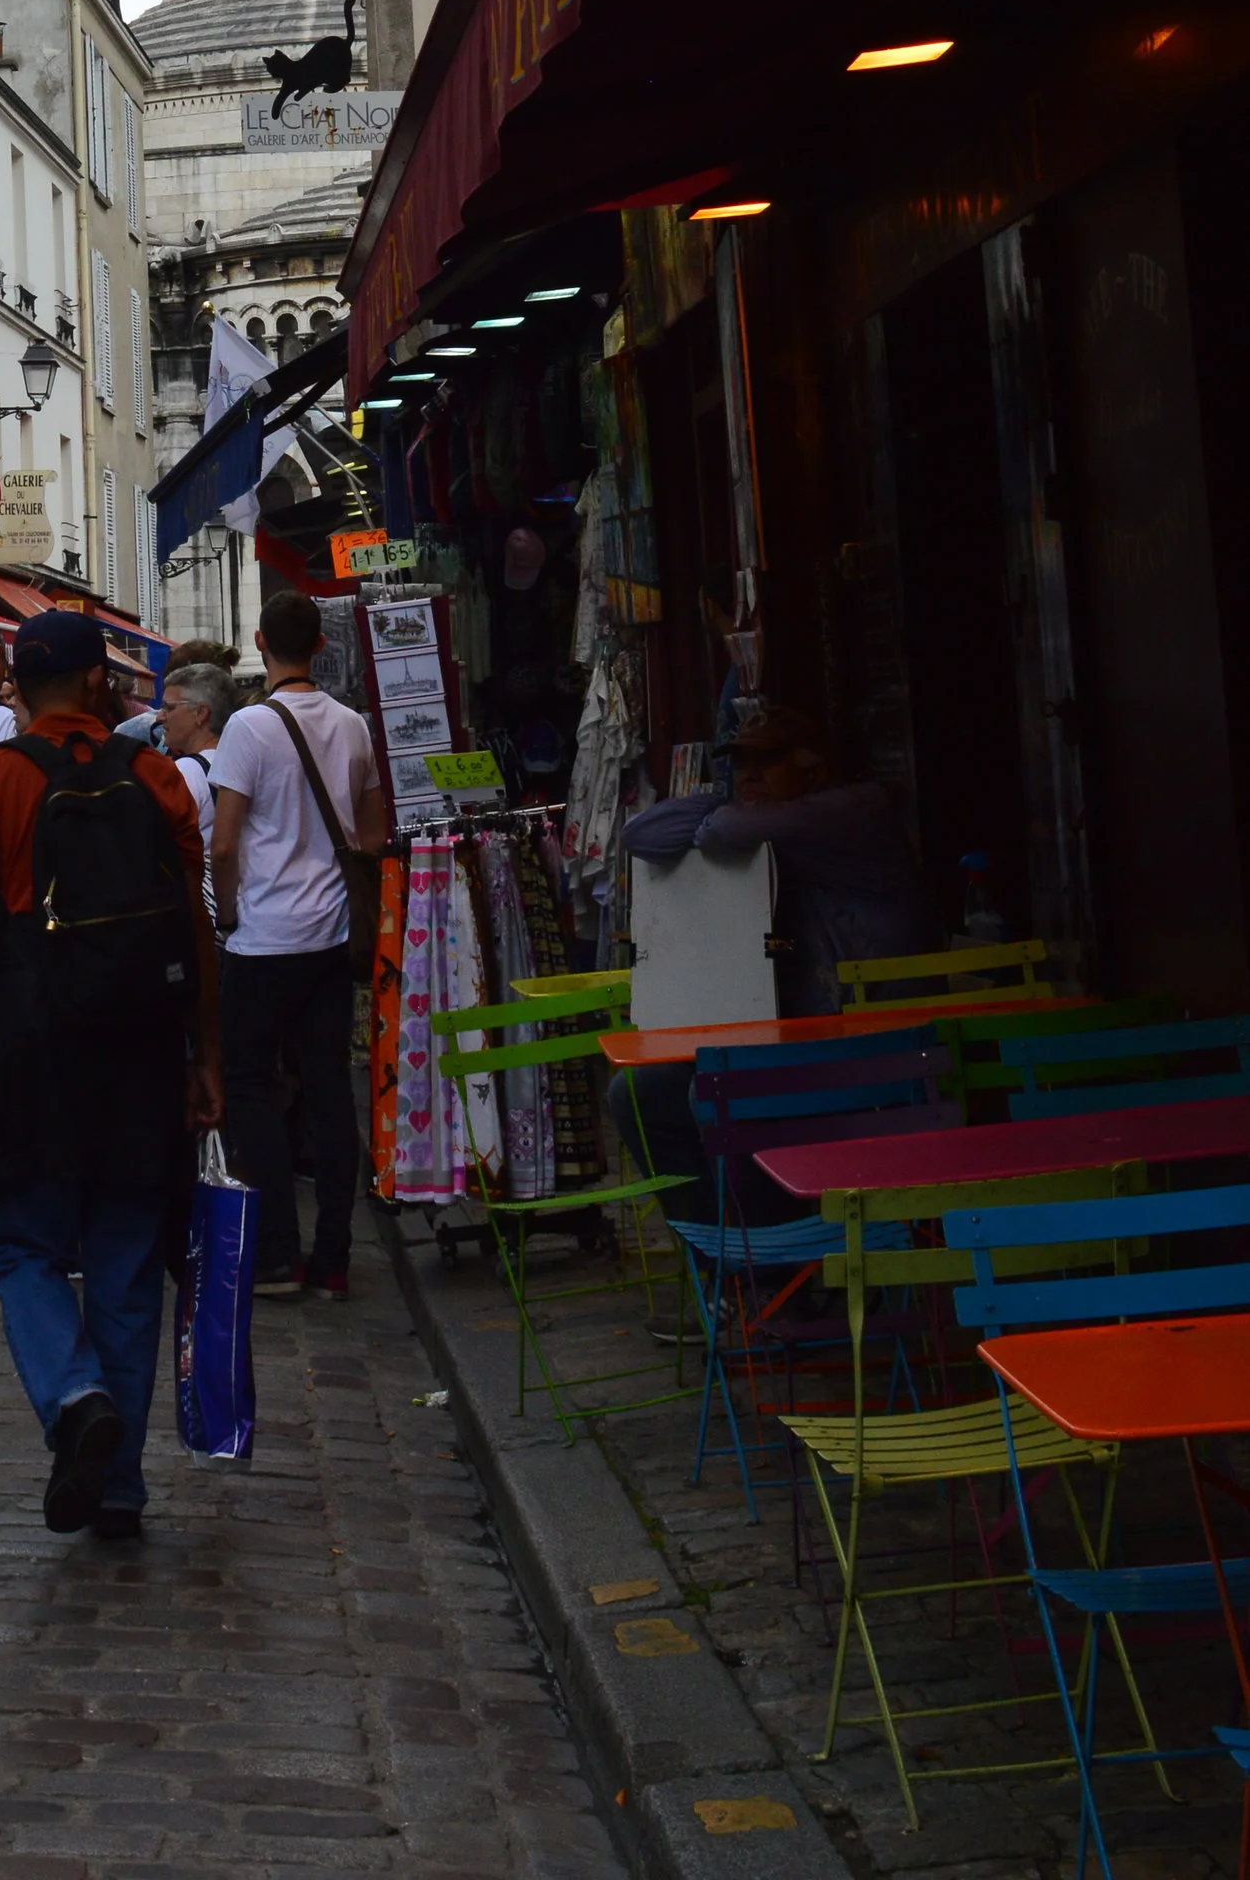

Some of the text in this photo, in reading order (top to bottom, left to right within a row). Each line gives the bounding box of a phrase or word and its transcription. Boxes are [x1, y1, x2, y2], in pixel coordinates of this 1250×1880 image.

[246, 103, 268, 131] LE
[279, 103, 341, 130] CHAT
[247, 133, 285, 147] GALERIE
[290, 133, 319, 147] D'ART
[3, 474, 44, 488] GALERIE
[16, 490, 27, 500] DU
